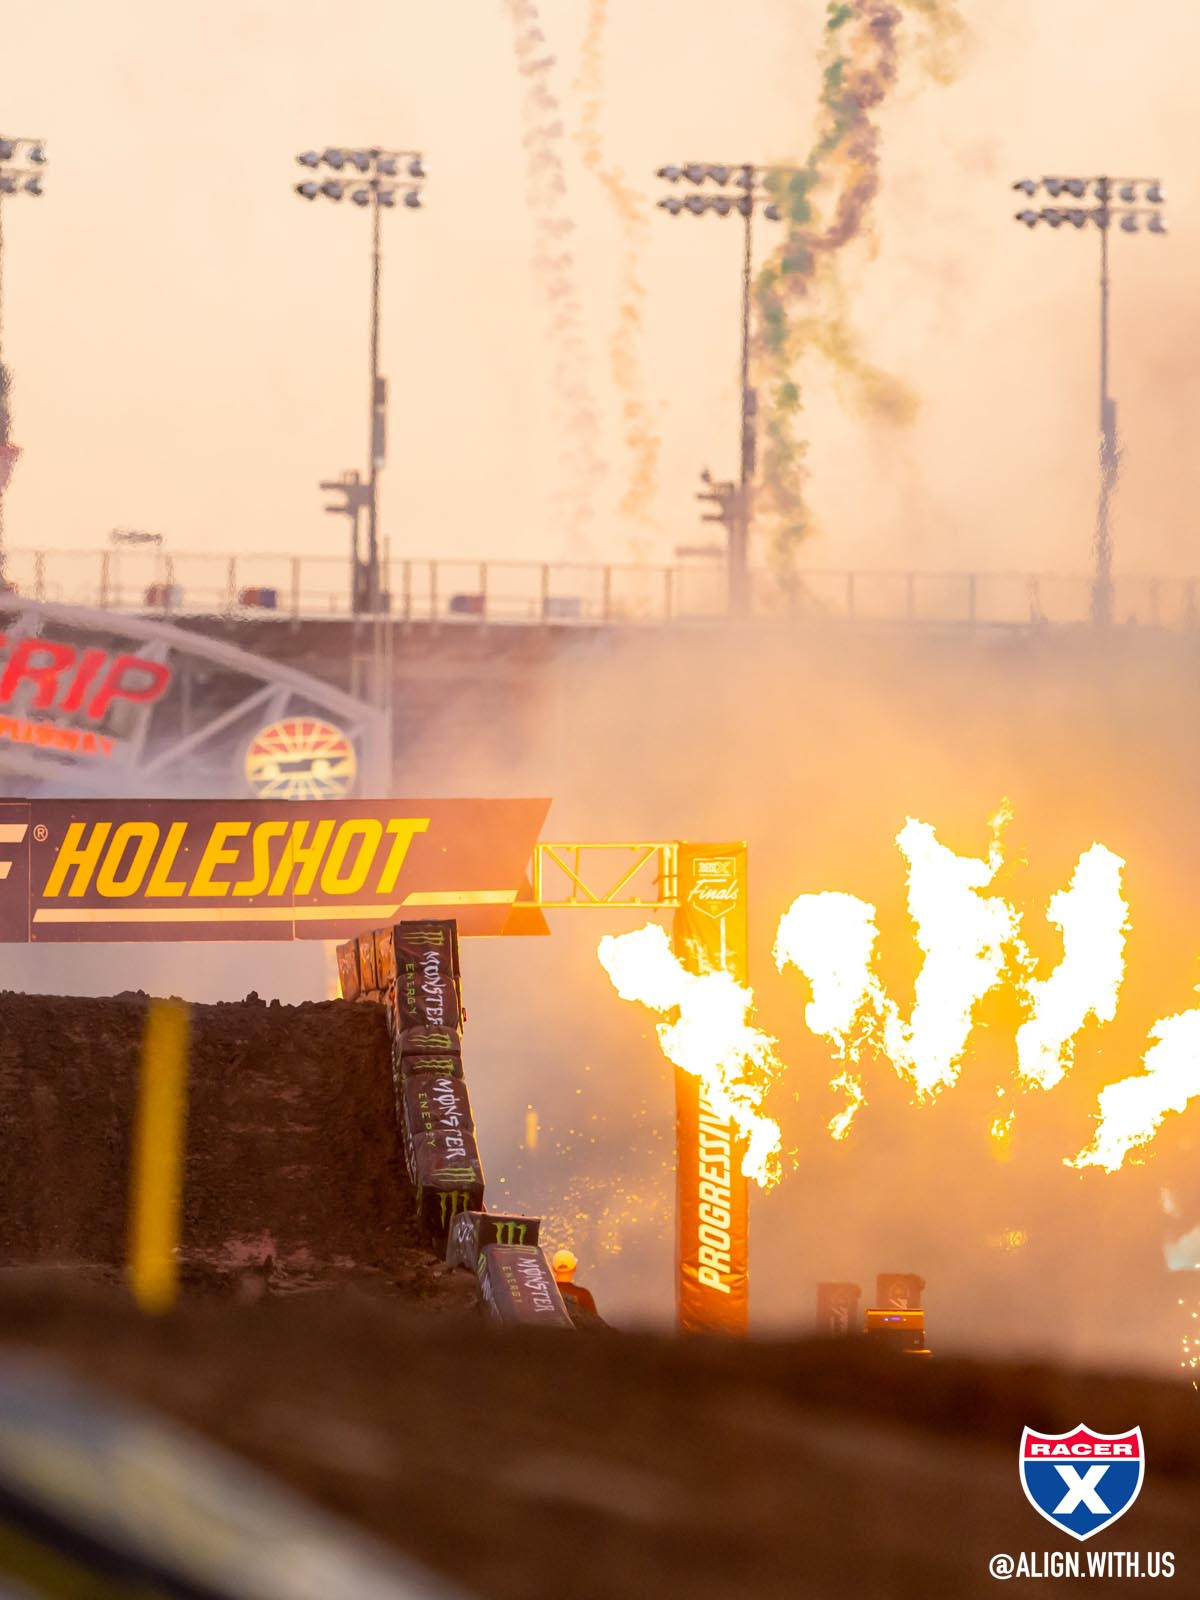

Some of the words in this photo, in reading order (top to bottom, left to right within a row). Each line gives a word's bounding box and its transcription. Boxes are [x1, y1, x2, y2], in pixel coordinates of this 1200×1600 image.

[43, 818, 431, 898] HOLESHOT
[432, 1078, 467, 1160] MONSTER
[698, 1085, 731, 1294] PROGRESSIV
[517, 1257, 555, 1312] MONSTER
